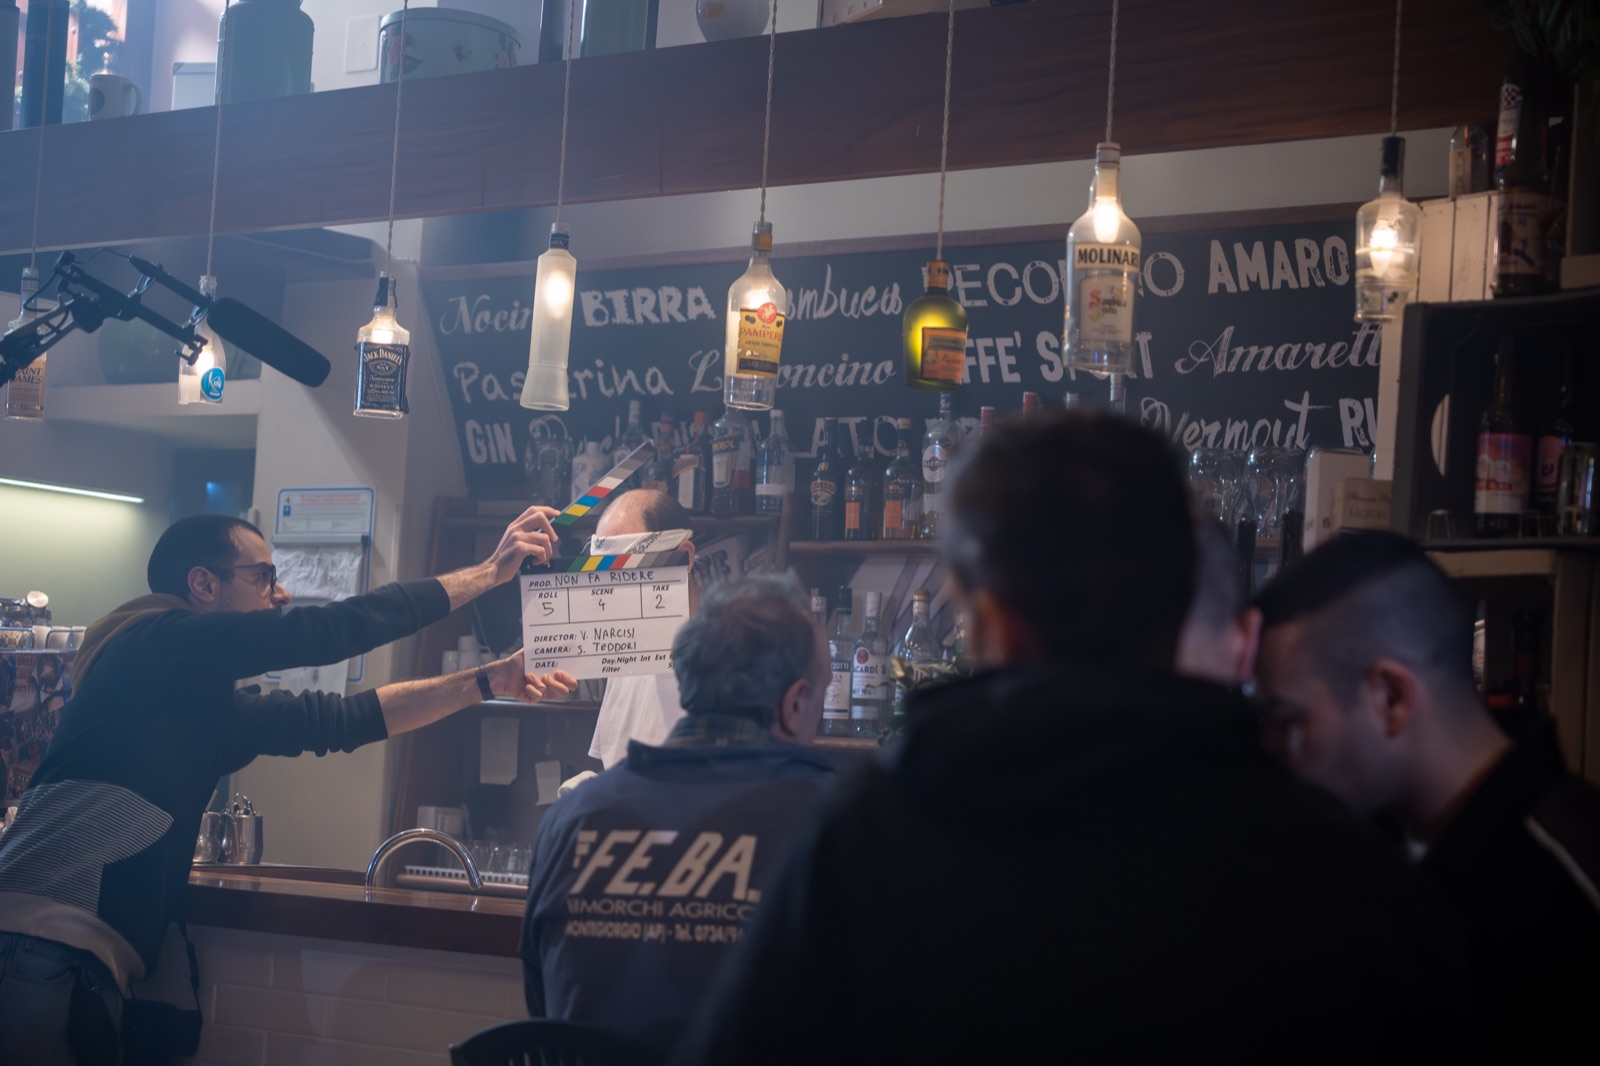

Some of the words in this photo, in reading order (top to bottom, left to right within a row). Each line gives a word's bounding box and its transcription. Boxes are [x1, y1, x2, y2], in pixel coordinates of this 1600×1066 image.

[580, 286, 716, 327] BIRRA
[1208, 235, 1349, 295] AMARO
[363, 350, 379, 363] JACK
[16, 367, 41, 375] AINT
[453, 362, 674, 404] Pasrina
[688, 349, 898, 395] Loncino
[961, 331, 1022, 384] FFE'
[14, 375, 41, 384] AMES
[464, 419, 517, 464] GIN
[529, 580, 552, 588] PROD.
[555, 574, 579, 587] NON
[588, 573, 601, 584] FA
[538, 591, 558, 599] ROLL
[590, 588, 614, 596] SCENE
[652, 584, 670, 592] TAKE
[542, 602, 555, 617] 5
[598, 598, 606, 612] 4
[655, 594, 666, 610] 2
[533, 634, 577, 643] DIRECTOR:
[594, 627, 635, 640] NARCISI
[534, 647, 571, 655] CAMERA:
[535, 661, 559, 669] DATE:
[640, 654, 651, 662] Int
[655, 653, 666, 661] Ext
